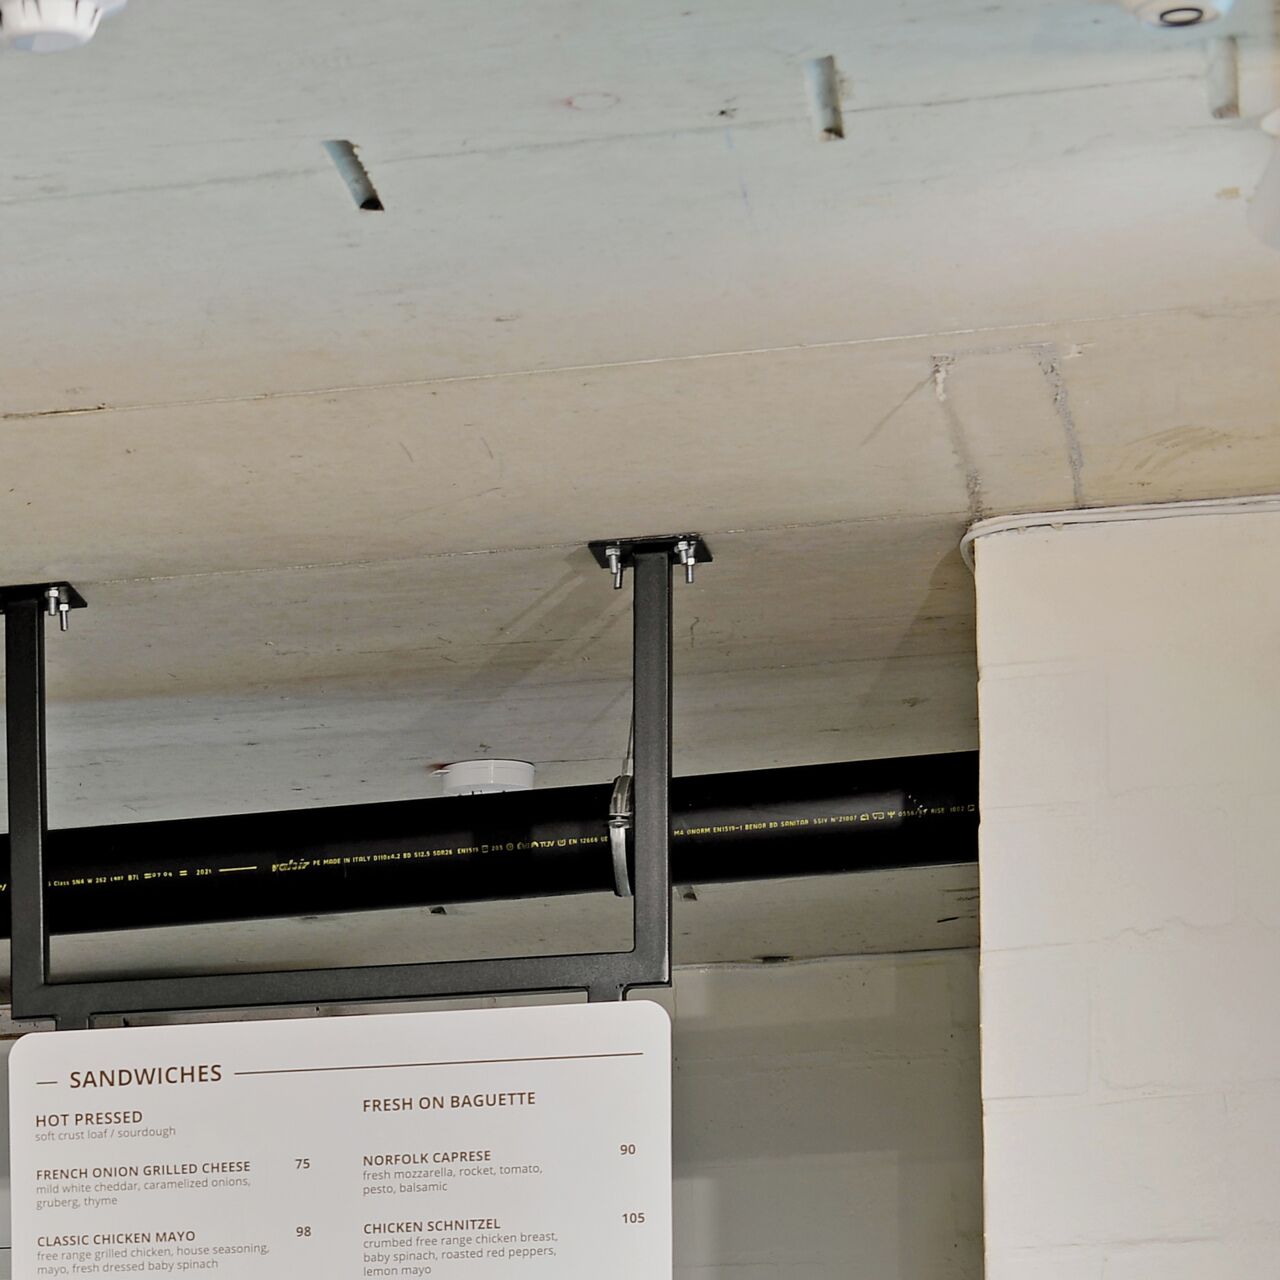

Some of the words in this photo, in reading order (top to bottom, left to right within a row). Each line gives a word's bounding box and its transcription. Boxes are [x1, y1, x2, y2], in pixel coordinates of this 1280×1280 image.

[352, 855, 371, 863] ITALY
[70, 1064, 222, 1088] SANDWICHES
[363, 1098, 413, 1112] FRESH
[419, 1096, 444, 1110] ON
[450, 1092, 536, 1108] BAGUETTE
[36, 1114, 70, 1128] HOT
[75, 1110, 143, 1126] PRESSED
[35, 1130, 55, 1142] soft
[58, 1131, 85, 1141] crust
[87, 1128, 108, 1139] loaf
[117, 1126, 176, 1139] sourdough
[363, 1153, 429, 1166] NORFOLK
[432, 1150, 491, 1163] CAPRESE
[620, 1144, 636, 1156] 90
[36, 1168, 88, 1180] FRENCH
[92, 1166, 138, 1178] ONION
[143, 1164, 198, 1176] GRILLED
[202, 1161, 250, 1174] CHEESE
[295, 1158, 310, 1169] 75
[362, 1170, 391, 1180] fresh
[394, 1167, 456, 1179] mozzarella,
[459, 1166, 496, 1176] rocket,
[499, 1165, 543, 1175] tomato,
[363, 1185, 396, 1197] pesto,
[399, 1181, 448, 1193] balsamic
[36, 1198, 81, 1211] gruberg,
[84, 1196, 118, 1208] thyme
[364, 1221, 423, 1234] CHICKEN
[427, 1218, 501, 1232] SCHNITZEL
[622, 1212, 645, 1224] 105
[37, 1234, 89, 1247] CLASSIC
[93, 1232, 151, 1245] CHICKEN
[156, 1230, 196, 1242] MAYO
[296, 1226, 312, 1237] 98
